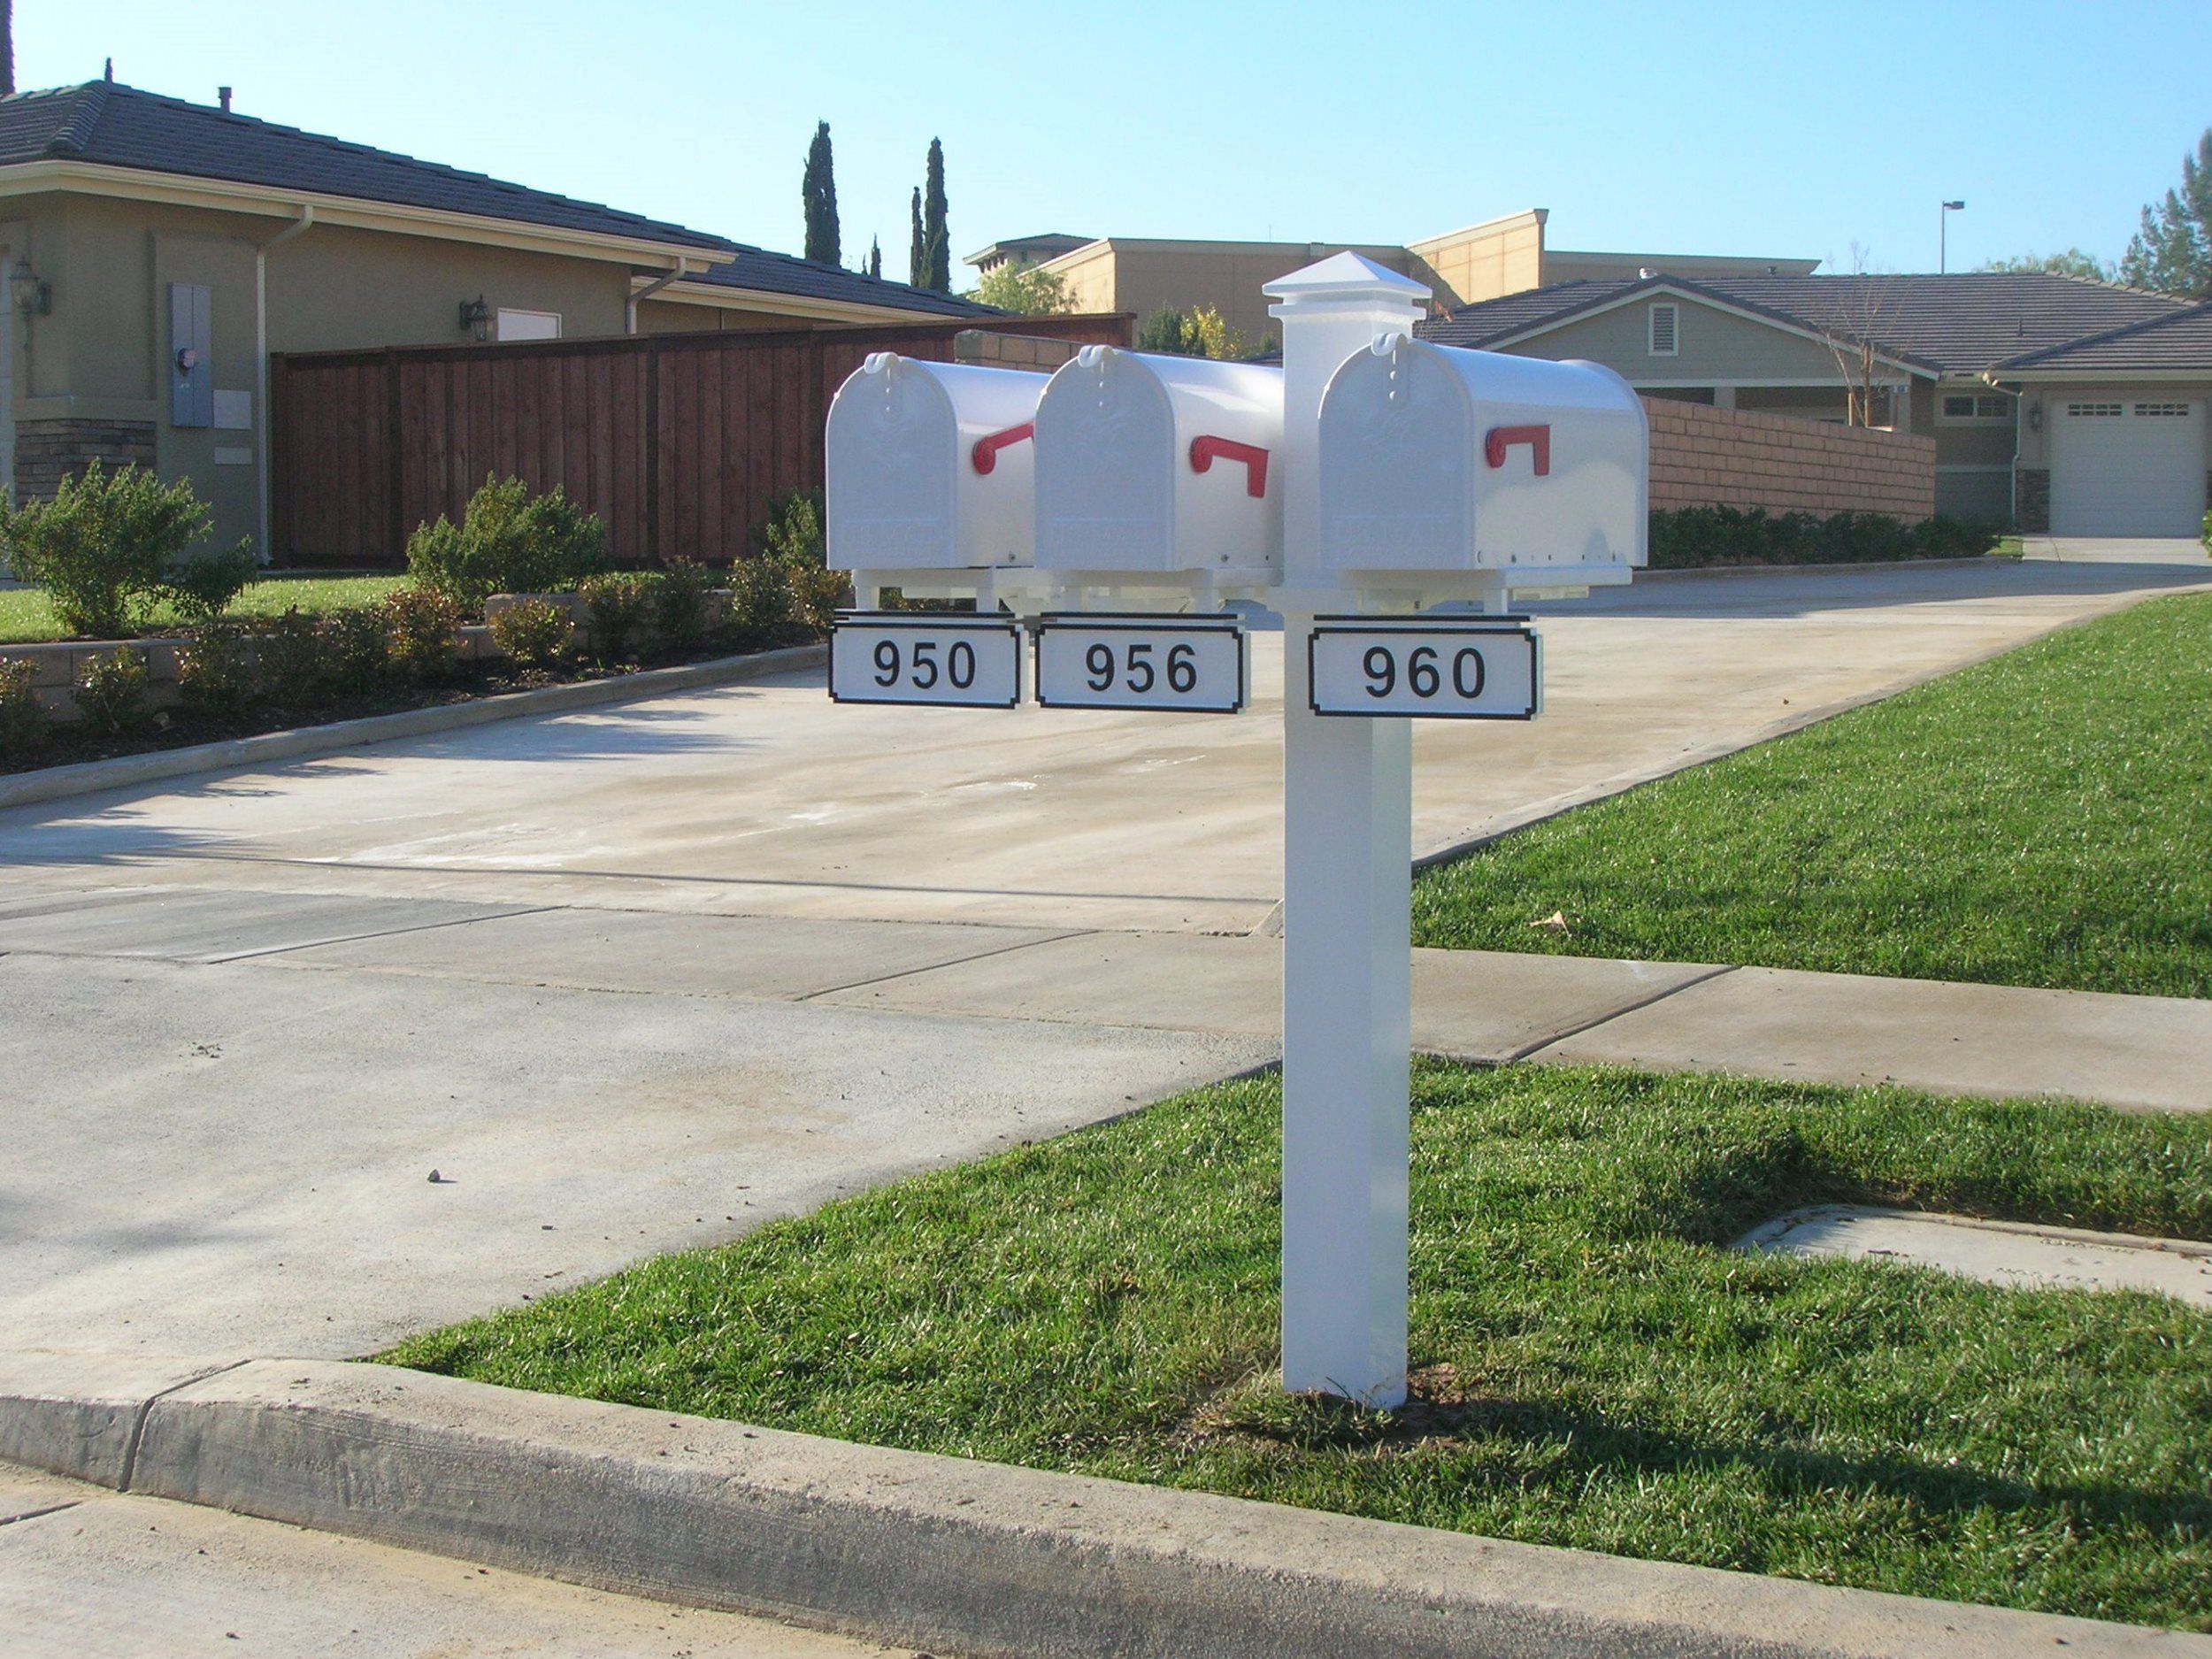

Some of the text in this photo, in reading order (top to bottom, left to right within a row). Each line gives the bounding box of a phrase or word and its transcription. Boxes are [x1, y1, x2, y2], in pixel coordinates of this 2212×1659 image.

[873, 641, 976, 690] 950
[1086, 643, 1197, 694] 956
[1363, 647, 1486, 700] 960
